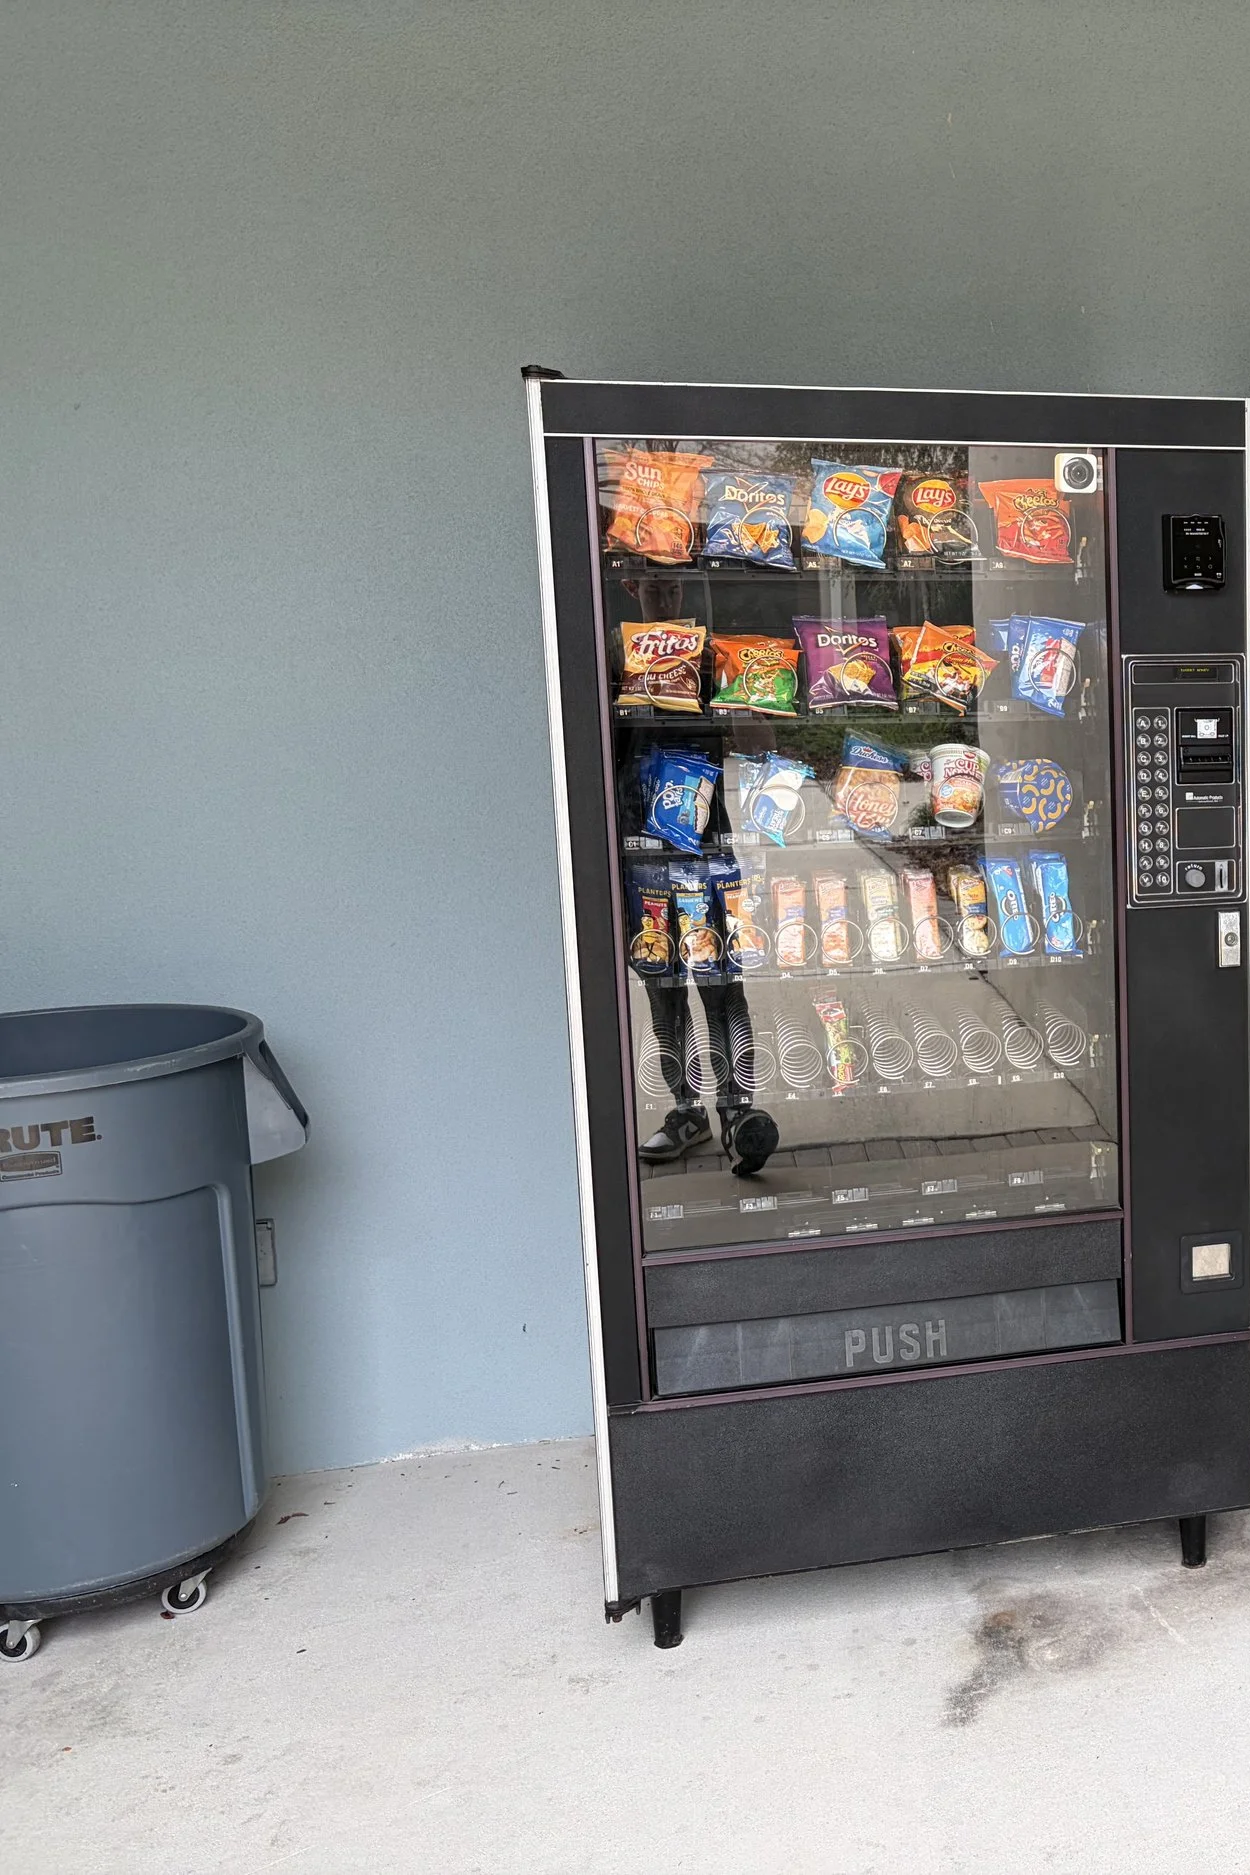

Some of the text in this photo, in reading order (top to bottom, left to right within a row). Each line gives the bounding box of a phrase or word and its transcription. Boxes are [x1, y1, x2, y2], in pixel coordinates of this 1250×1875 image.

[625, 462, 662, 481] Sun
[637, 478, 665, 491] CHIPS
[825, 478, 869, 503] Lay's
[723, 484, 786, 506] Doritos
[914, 486, 954, 507] Lay's
[631, 629, 699, 658] Fritos
[817, 633, 878, 648] Doritos
[658, 664, 687, 680] CHEESE
[955, 758, 980, 772] CUP
[1184, 863, 1203, 871] return
[844, 1319, 948, 1368] PUSH
